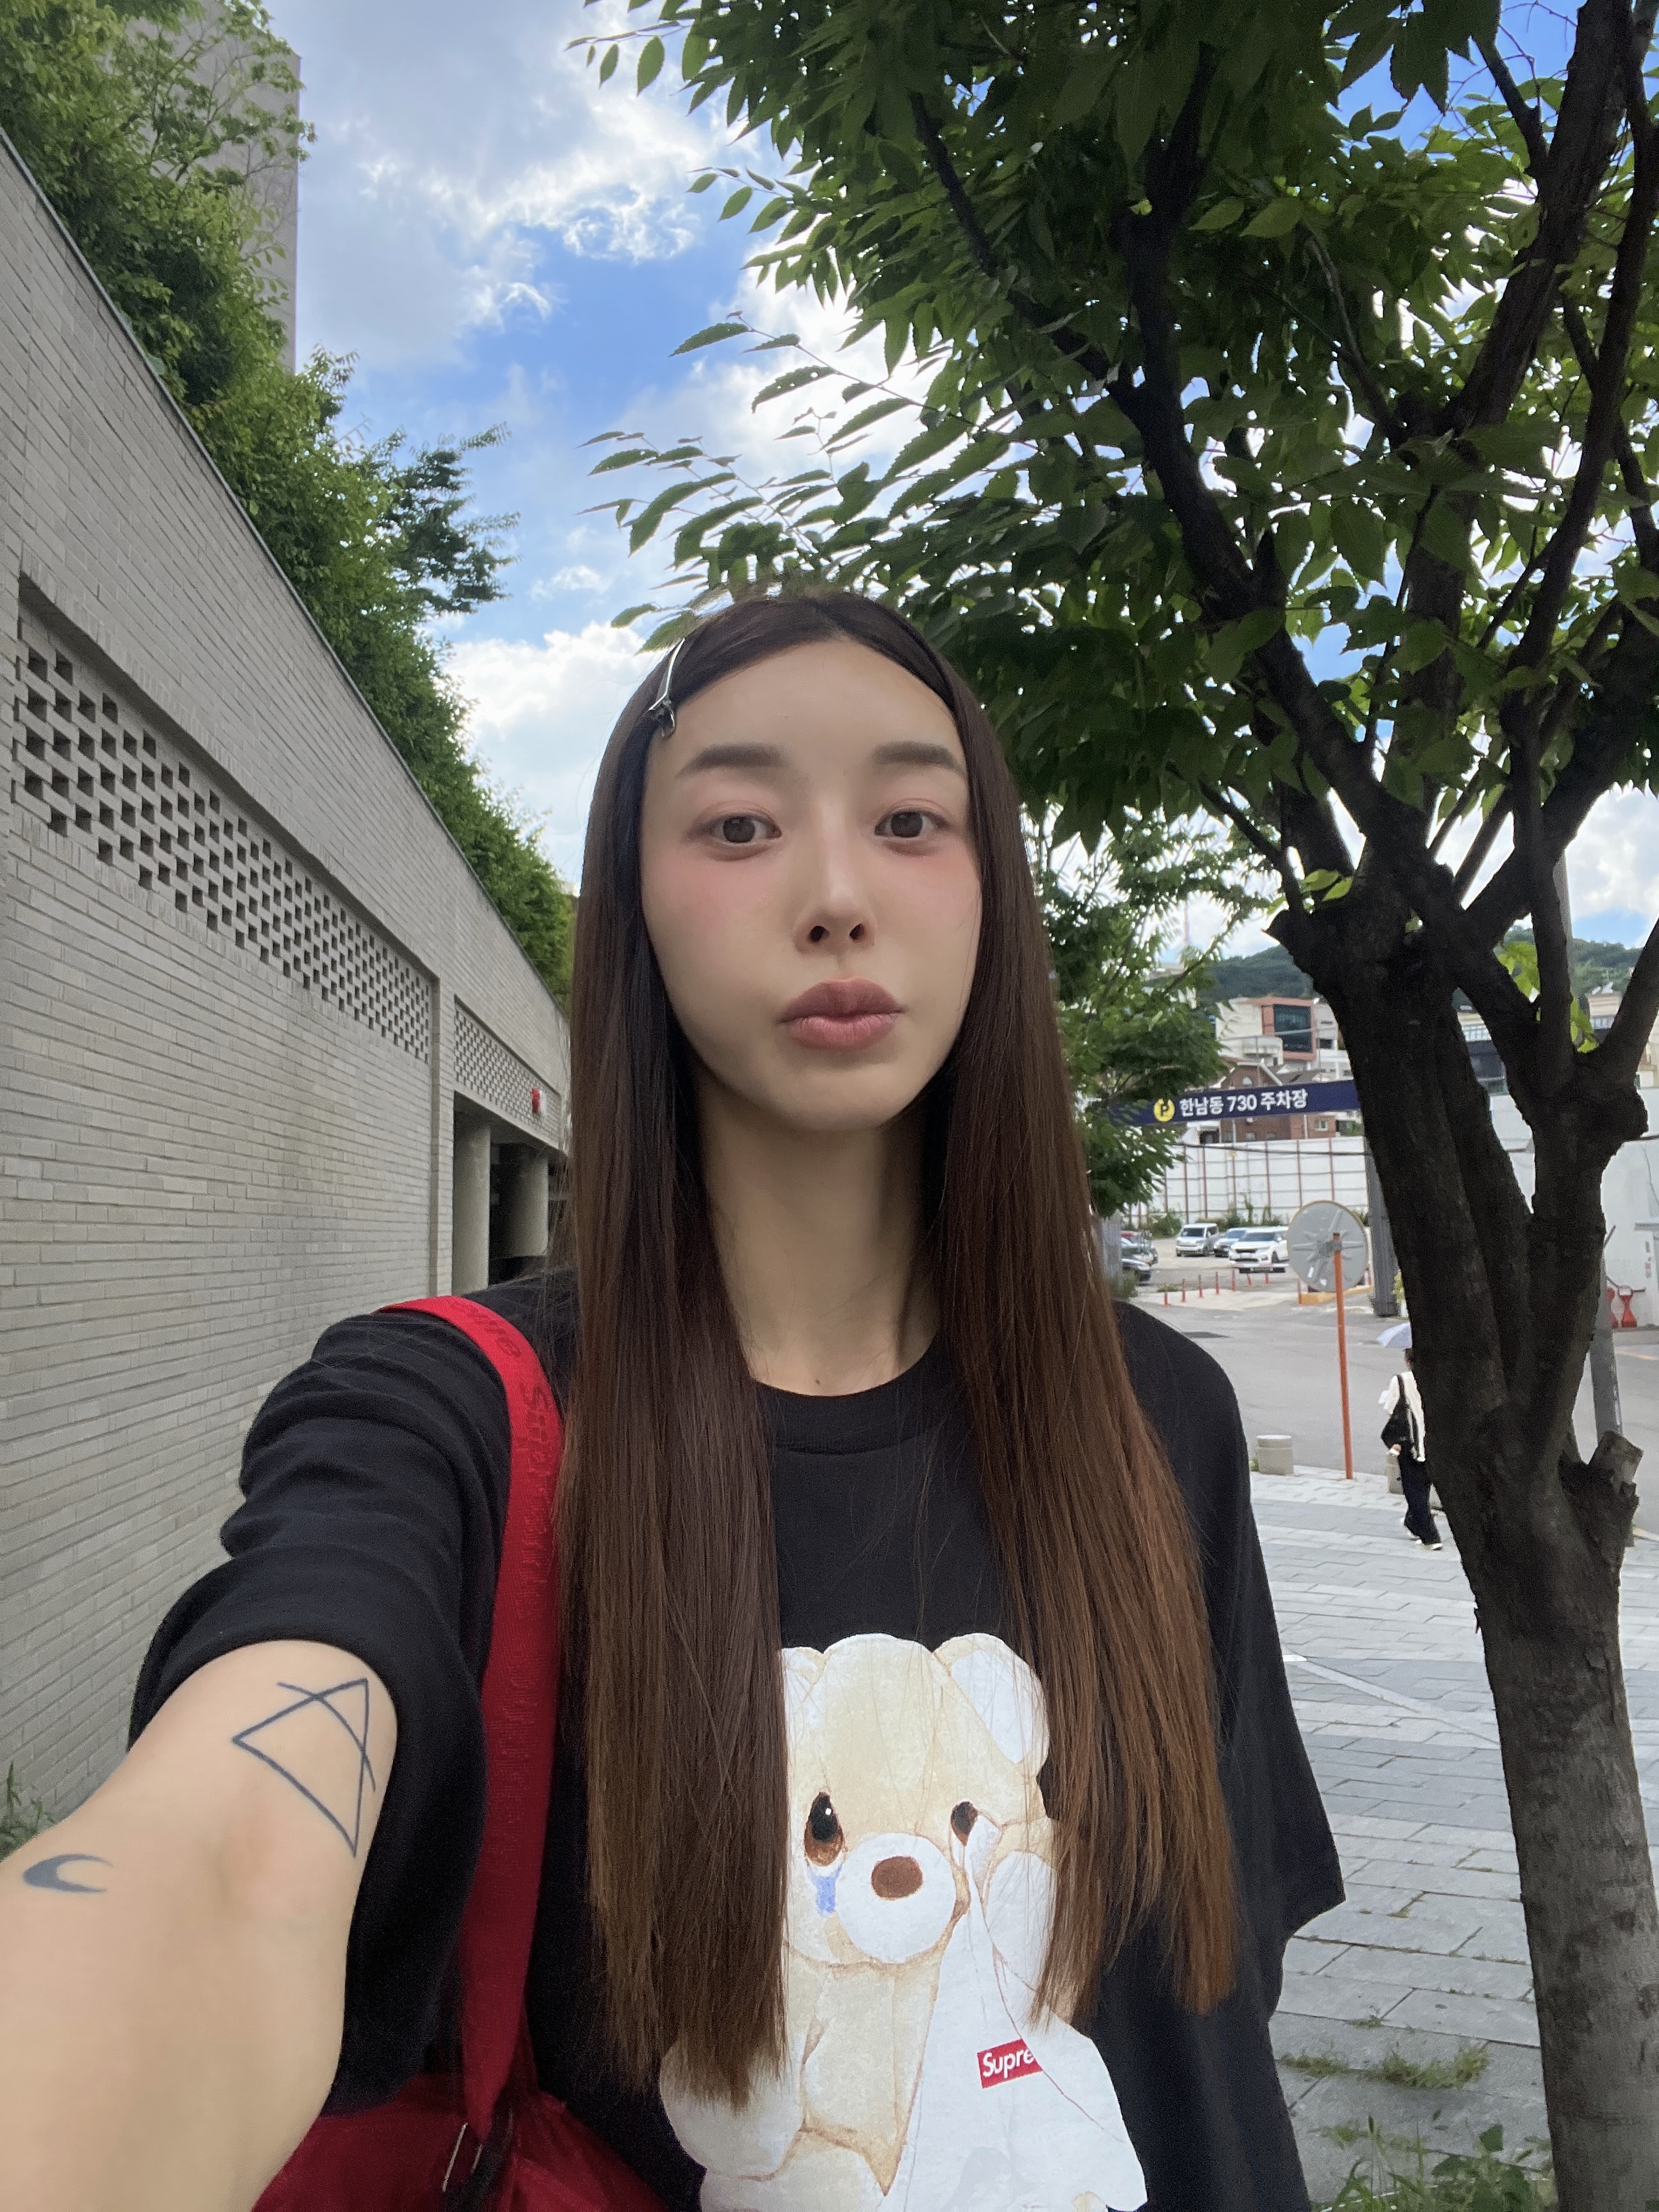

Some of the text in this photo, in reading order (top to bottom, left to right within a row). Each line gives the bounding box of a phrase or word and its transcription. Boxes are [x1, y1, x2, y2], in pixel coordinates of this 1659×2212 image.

[1179, 1097, 1224, 1117] 한남동
[1227, 1094, 1258, 1112] 730
[1260, 1088, 1308, 1111] 주차장
[982, 2049, 1035, 2079] Supre
